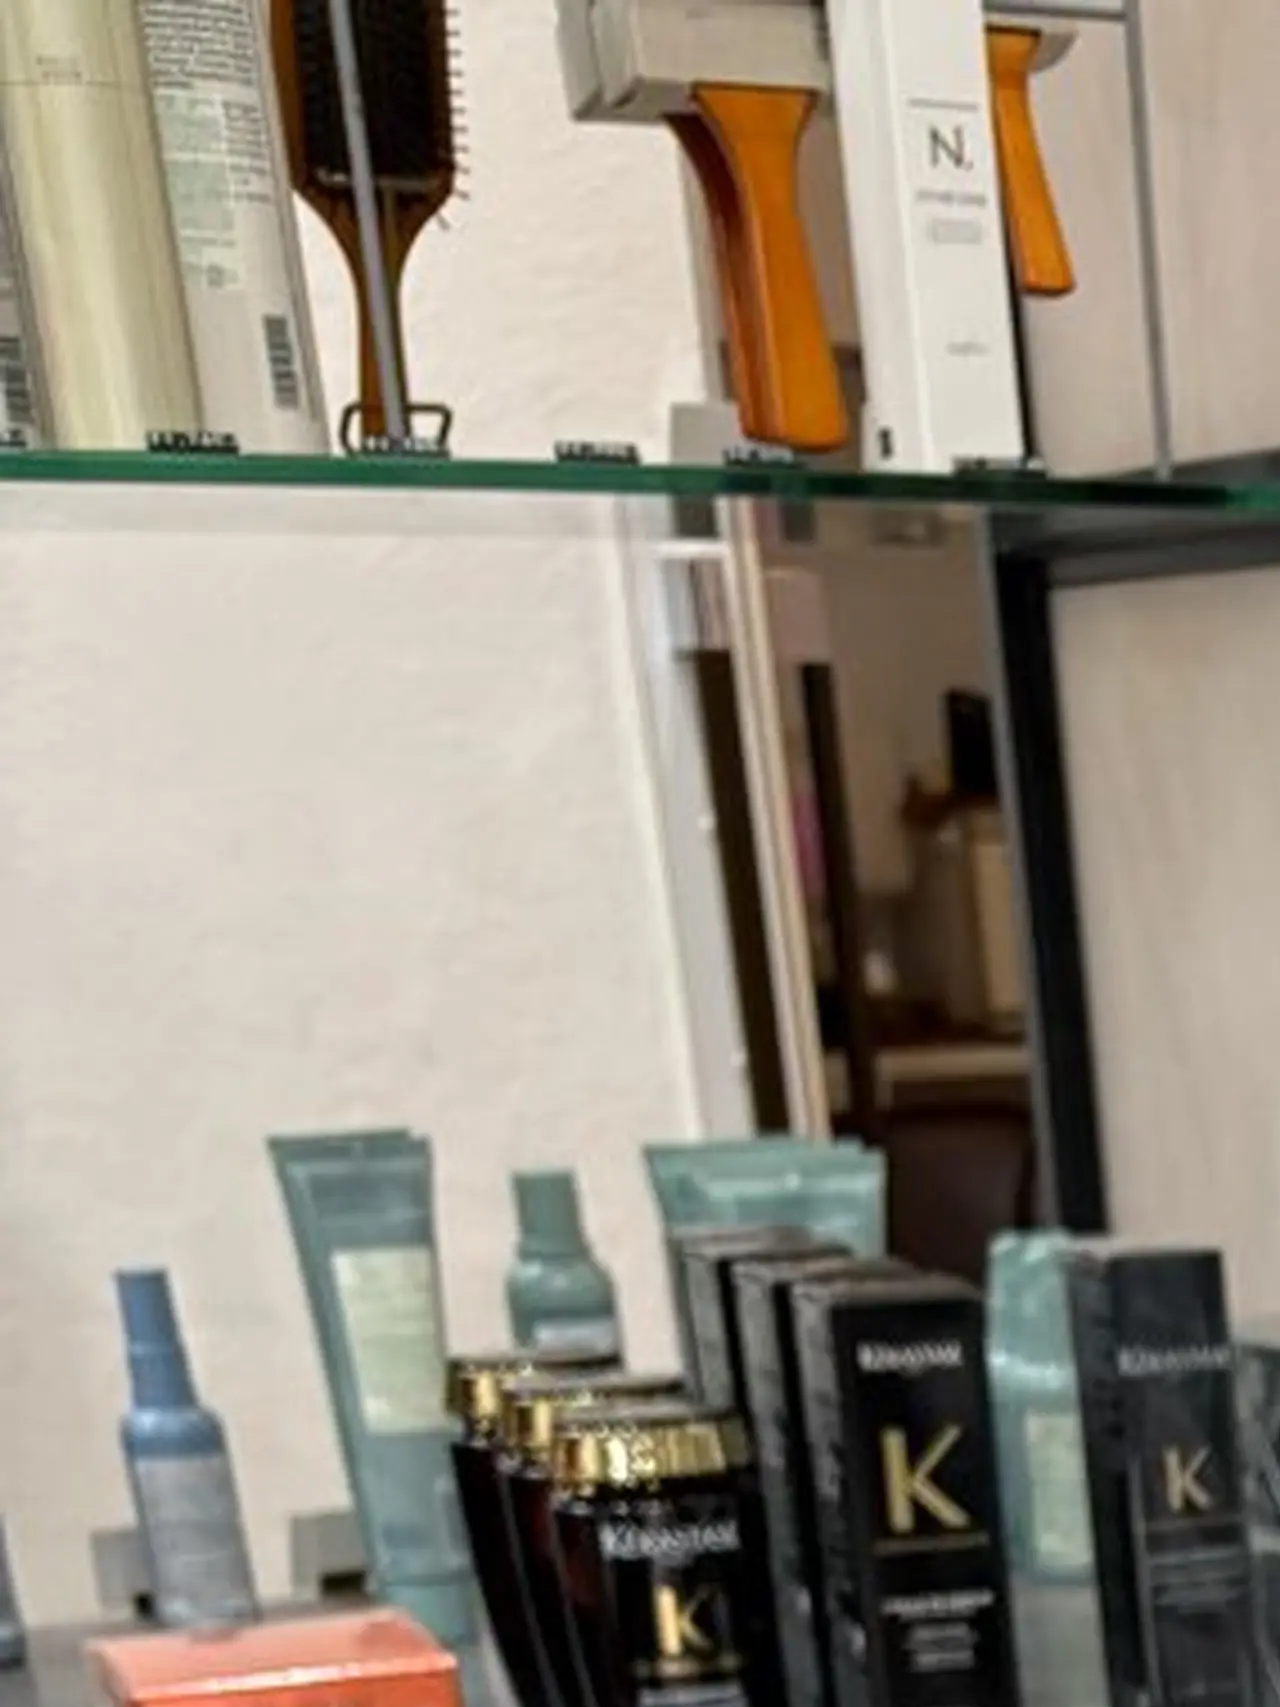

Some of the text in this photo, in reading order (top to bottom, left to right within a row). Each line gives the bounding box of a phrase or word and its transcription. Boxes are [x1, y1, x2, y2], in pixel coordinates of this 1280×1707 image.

[880, 1424, 970, 1533] K
[1163, 1446, 1213, 1513] K
[654, 1583, 712, 1656] K
